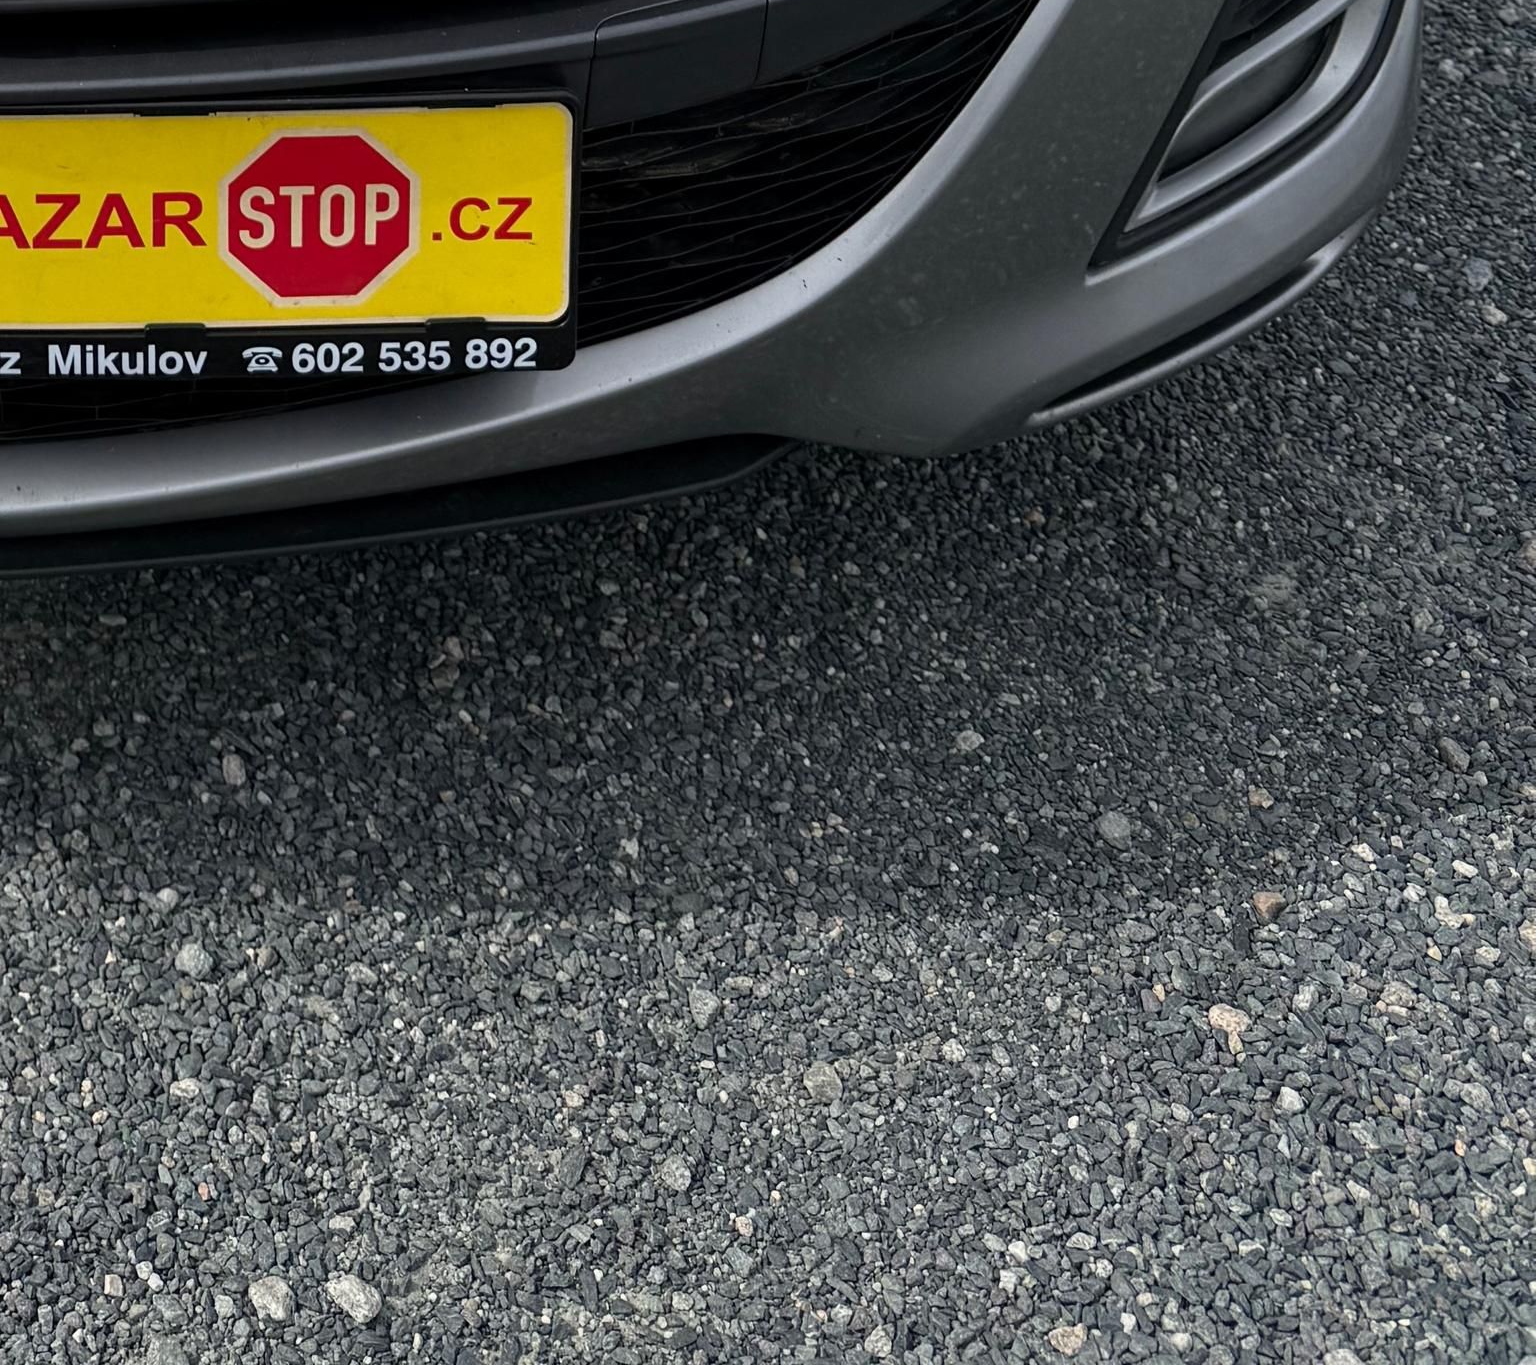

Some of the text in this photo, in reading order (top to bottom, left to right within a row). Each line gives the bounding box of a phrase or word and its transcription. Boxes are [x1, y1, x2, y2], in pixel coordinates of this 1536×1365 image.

[238, 182, 401, 250] STOP
[47, 343, 208, 376] Mikulov
[291, 341, 365, 373] 602
[378, 339, 451, 371] 535
[465, 336, 538, 369] 892
